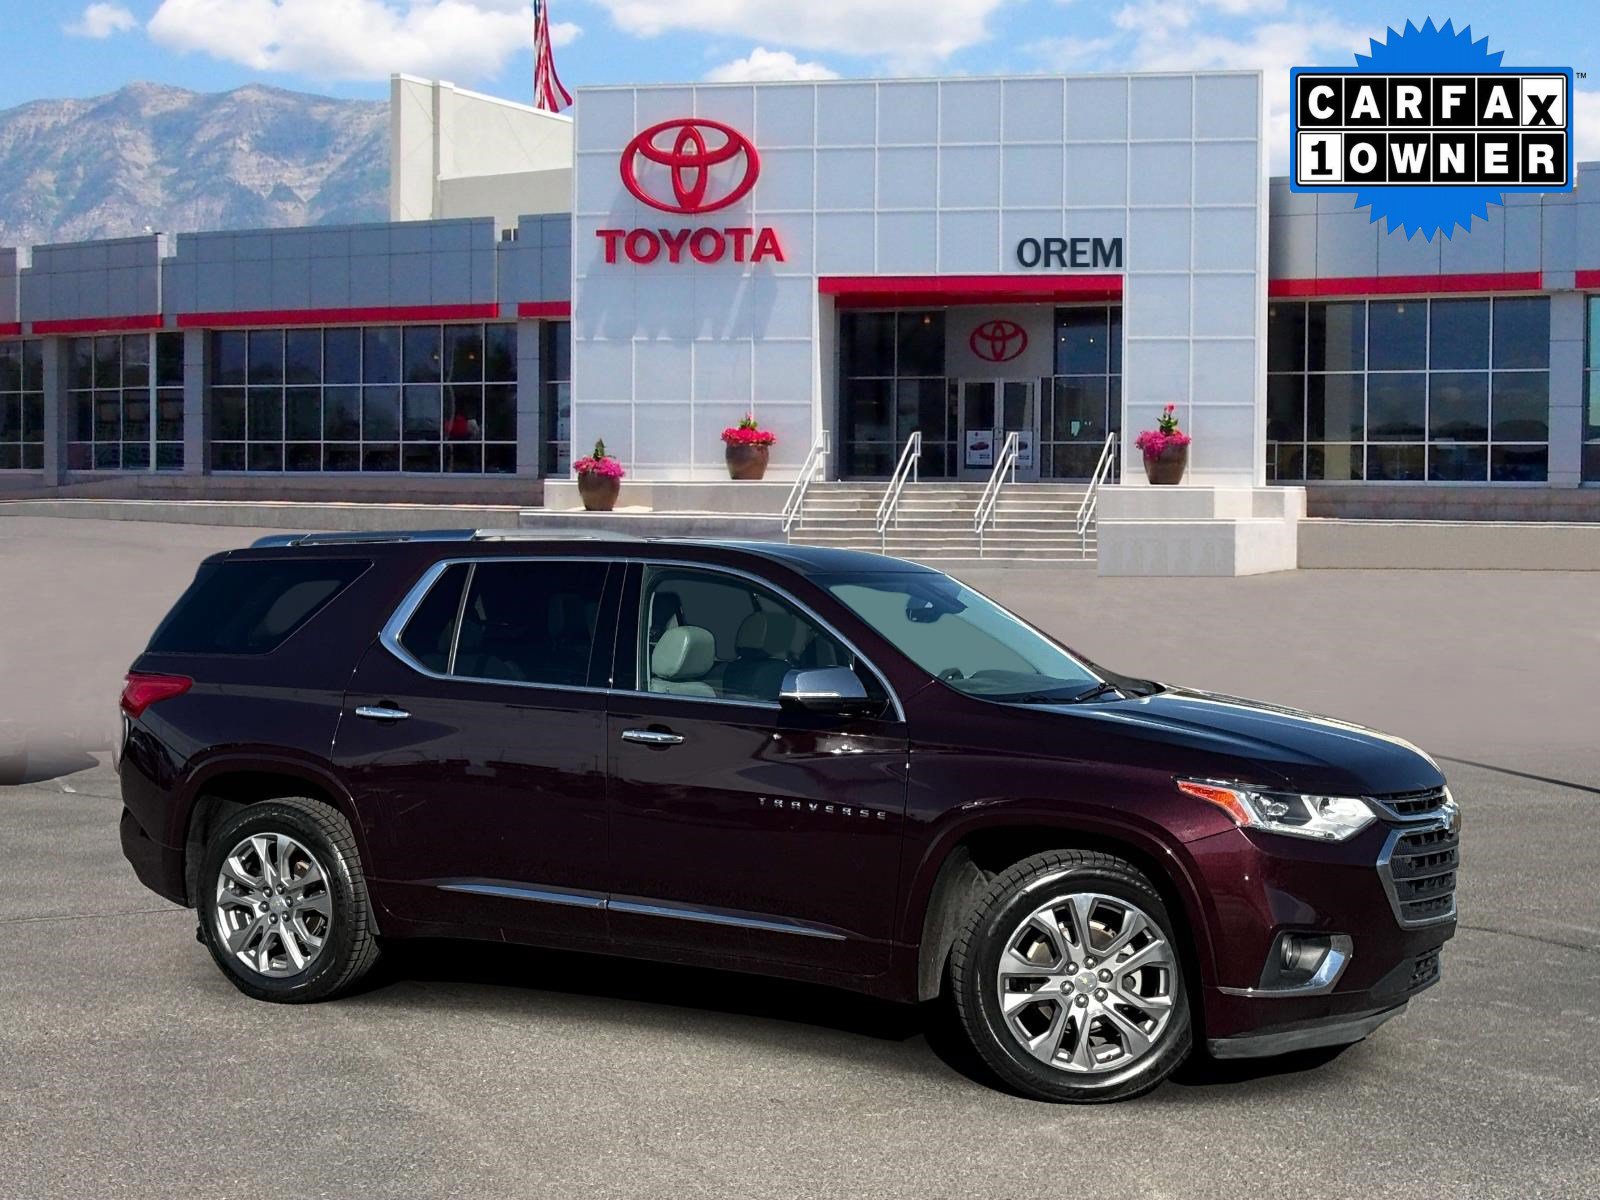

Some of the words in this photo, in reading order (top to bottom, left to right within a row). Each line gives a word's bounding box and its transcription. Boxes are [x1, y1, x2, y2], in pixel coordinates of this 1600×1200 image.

[596, 227, 785, 264] TOYOTA
[1016, 237, 1123, 268] OREM
[758, 797, 886, 820] TRAVERSE
